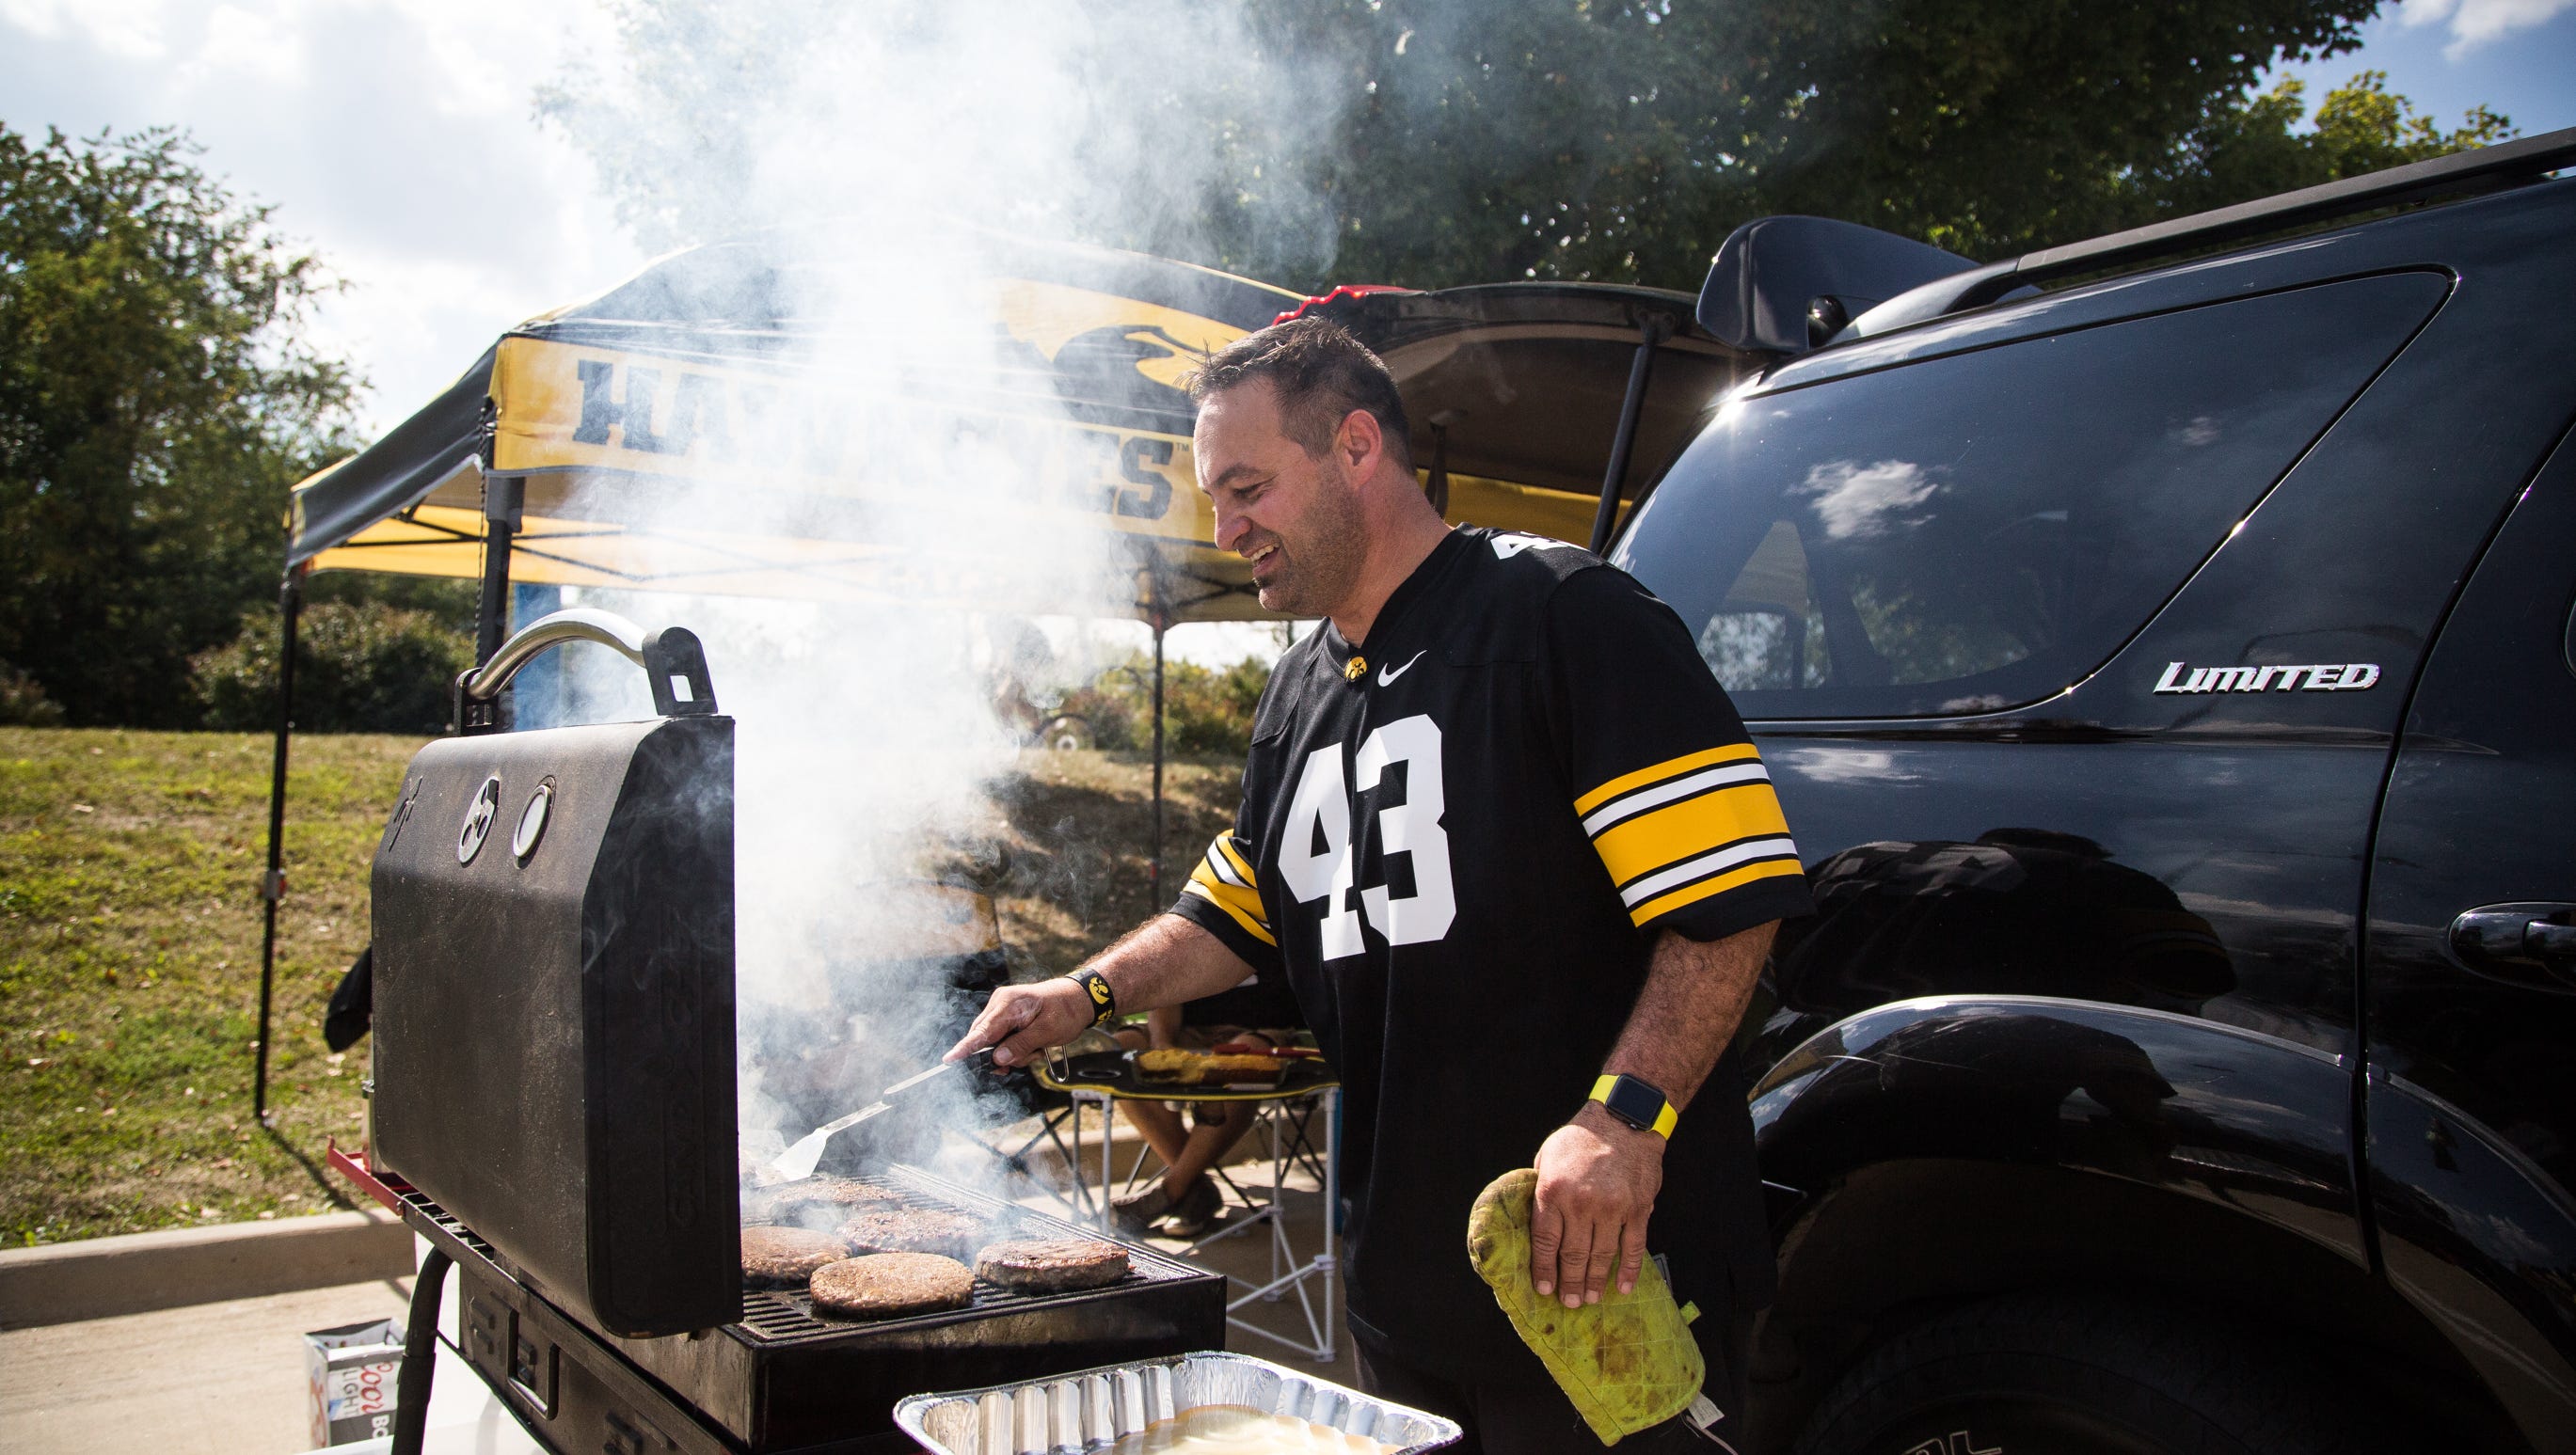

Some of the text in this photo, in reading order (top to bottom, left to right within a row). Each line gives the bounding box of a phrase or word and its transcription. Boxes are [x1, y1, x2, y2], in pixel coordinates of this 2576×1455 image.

[572, 359, 1190, 520] HAES TM
[2153, 661, 2381, 694] LIMITED
[1278, 714, 1456, 961] 43
